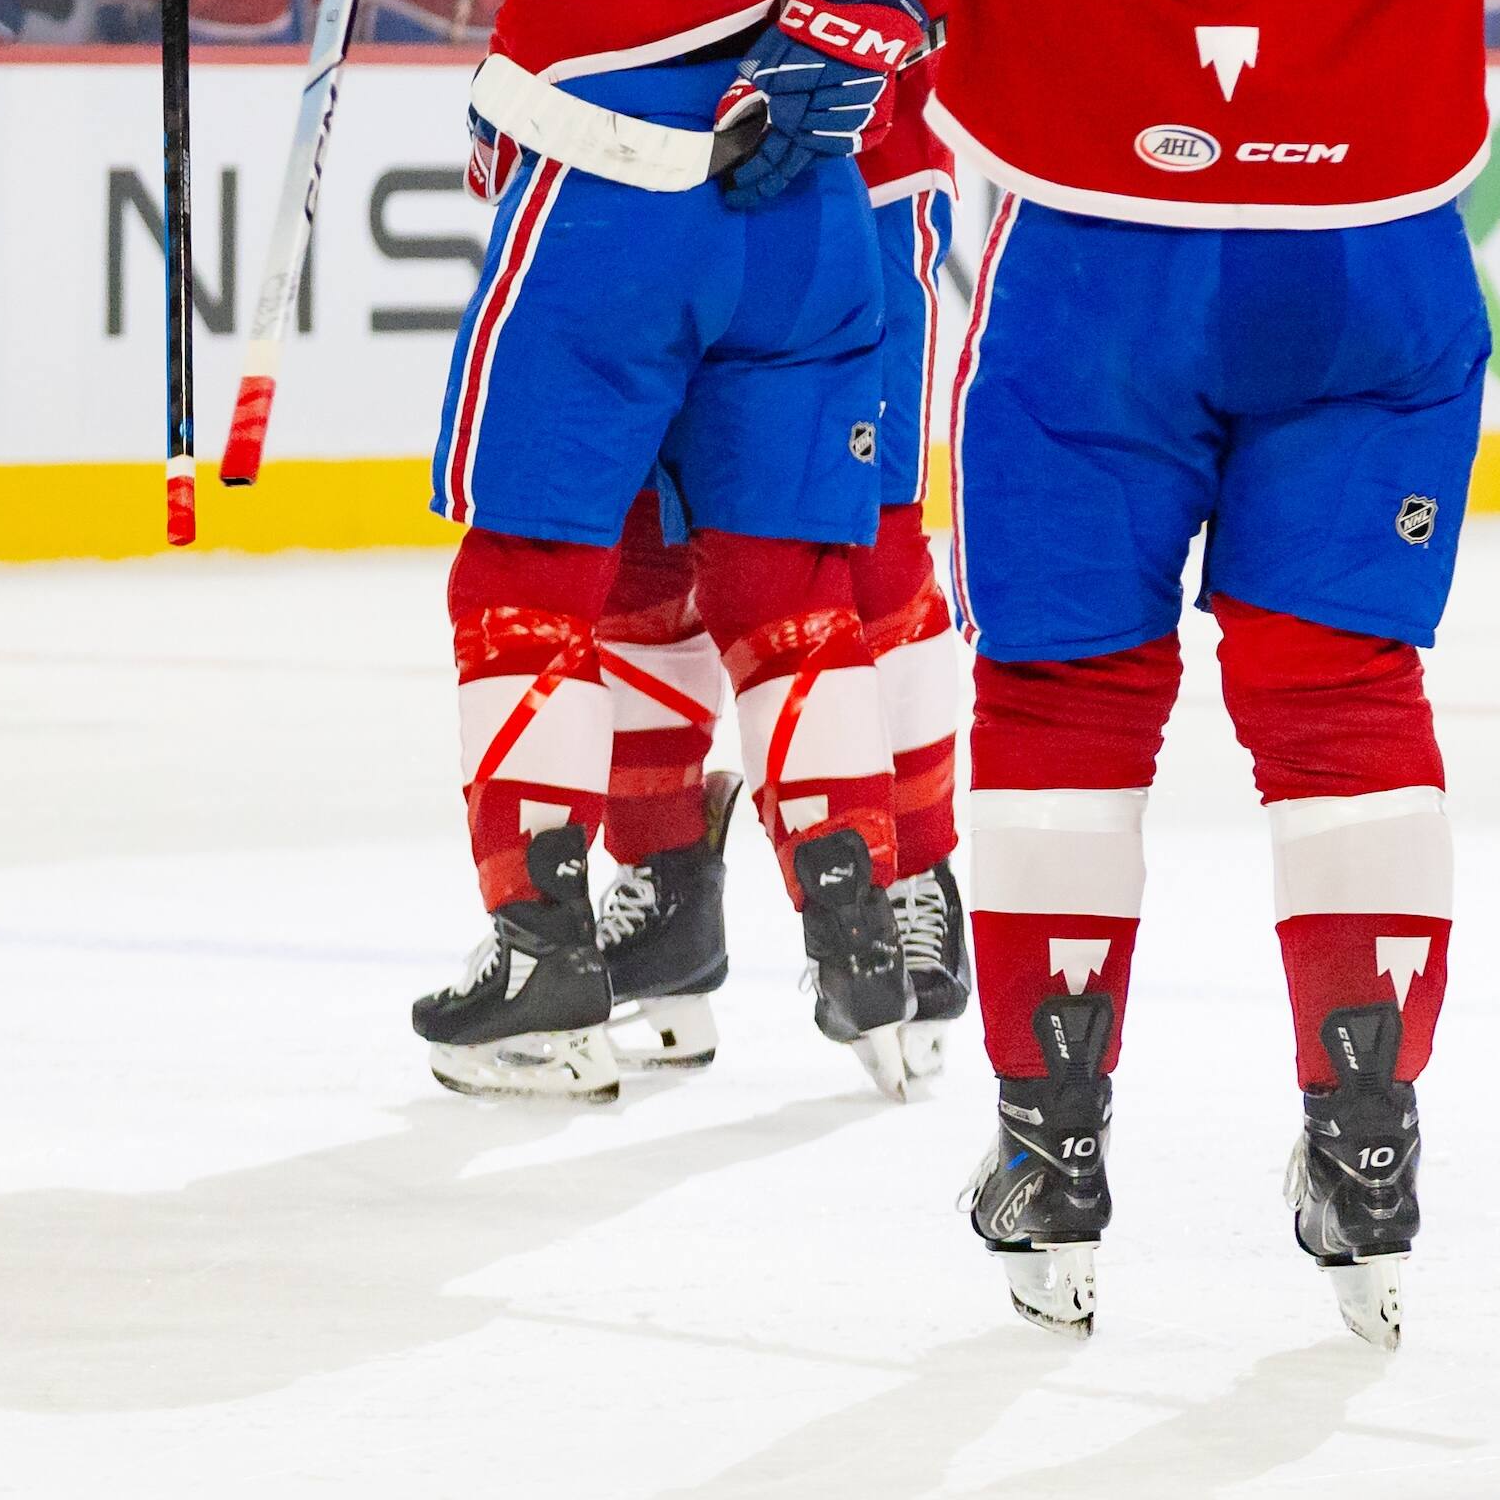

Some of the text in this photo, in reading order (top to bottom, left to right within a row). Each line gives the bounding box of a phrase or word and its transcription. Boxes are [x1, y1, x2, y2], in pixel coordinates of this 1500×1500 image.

[779, 0, 907, 65] CCM
[1152, 136, 1200, 159] AHL
[1235, 142, 1350, 164] CCM
[1403, 509, 1430, 531] NHL
[1050, 1014, 1071, 1060] CCM
[1336, 1026, 1360, 1071] CCM
[1060, 1136, 1097, 1159] 10
[1357, 1146, 1396, 1170] 10
[999, 1171, 1046, 1234] CCM
